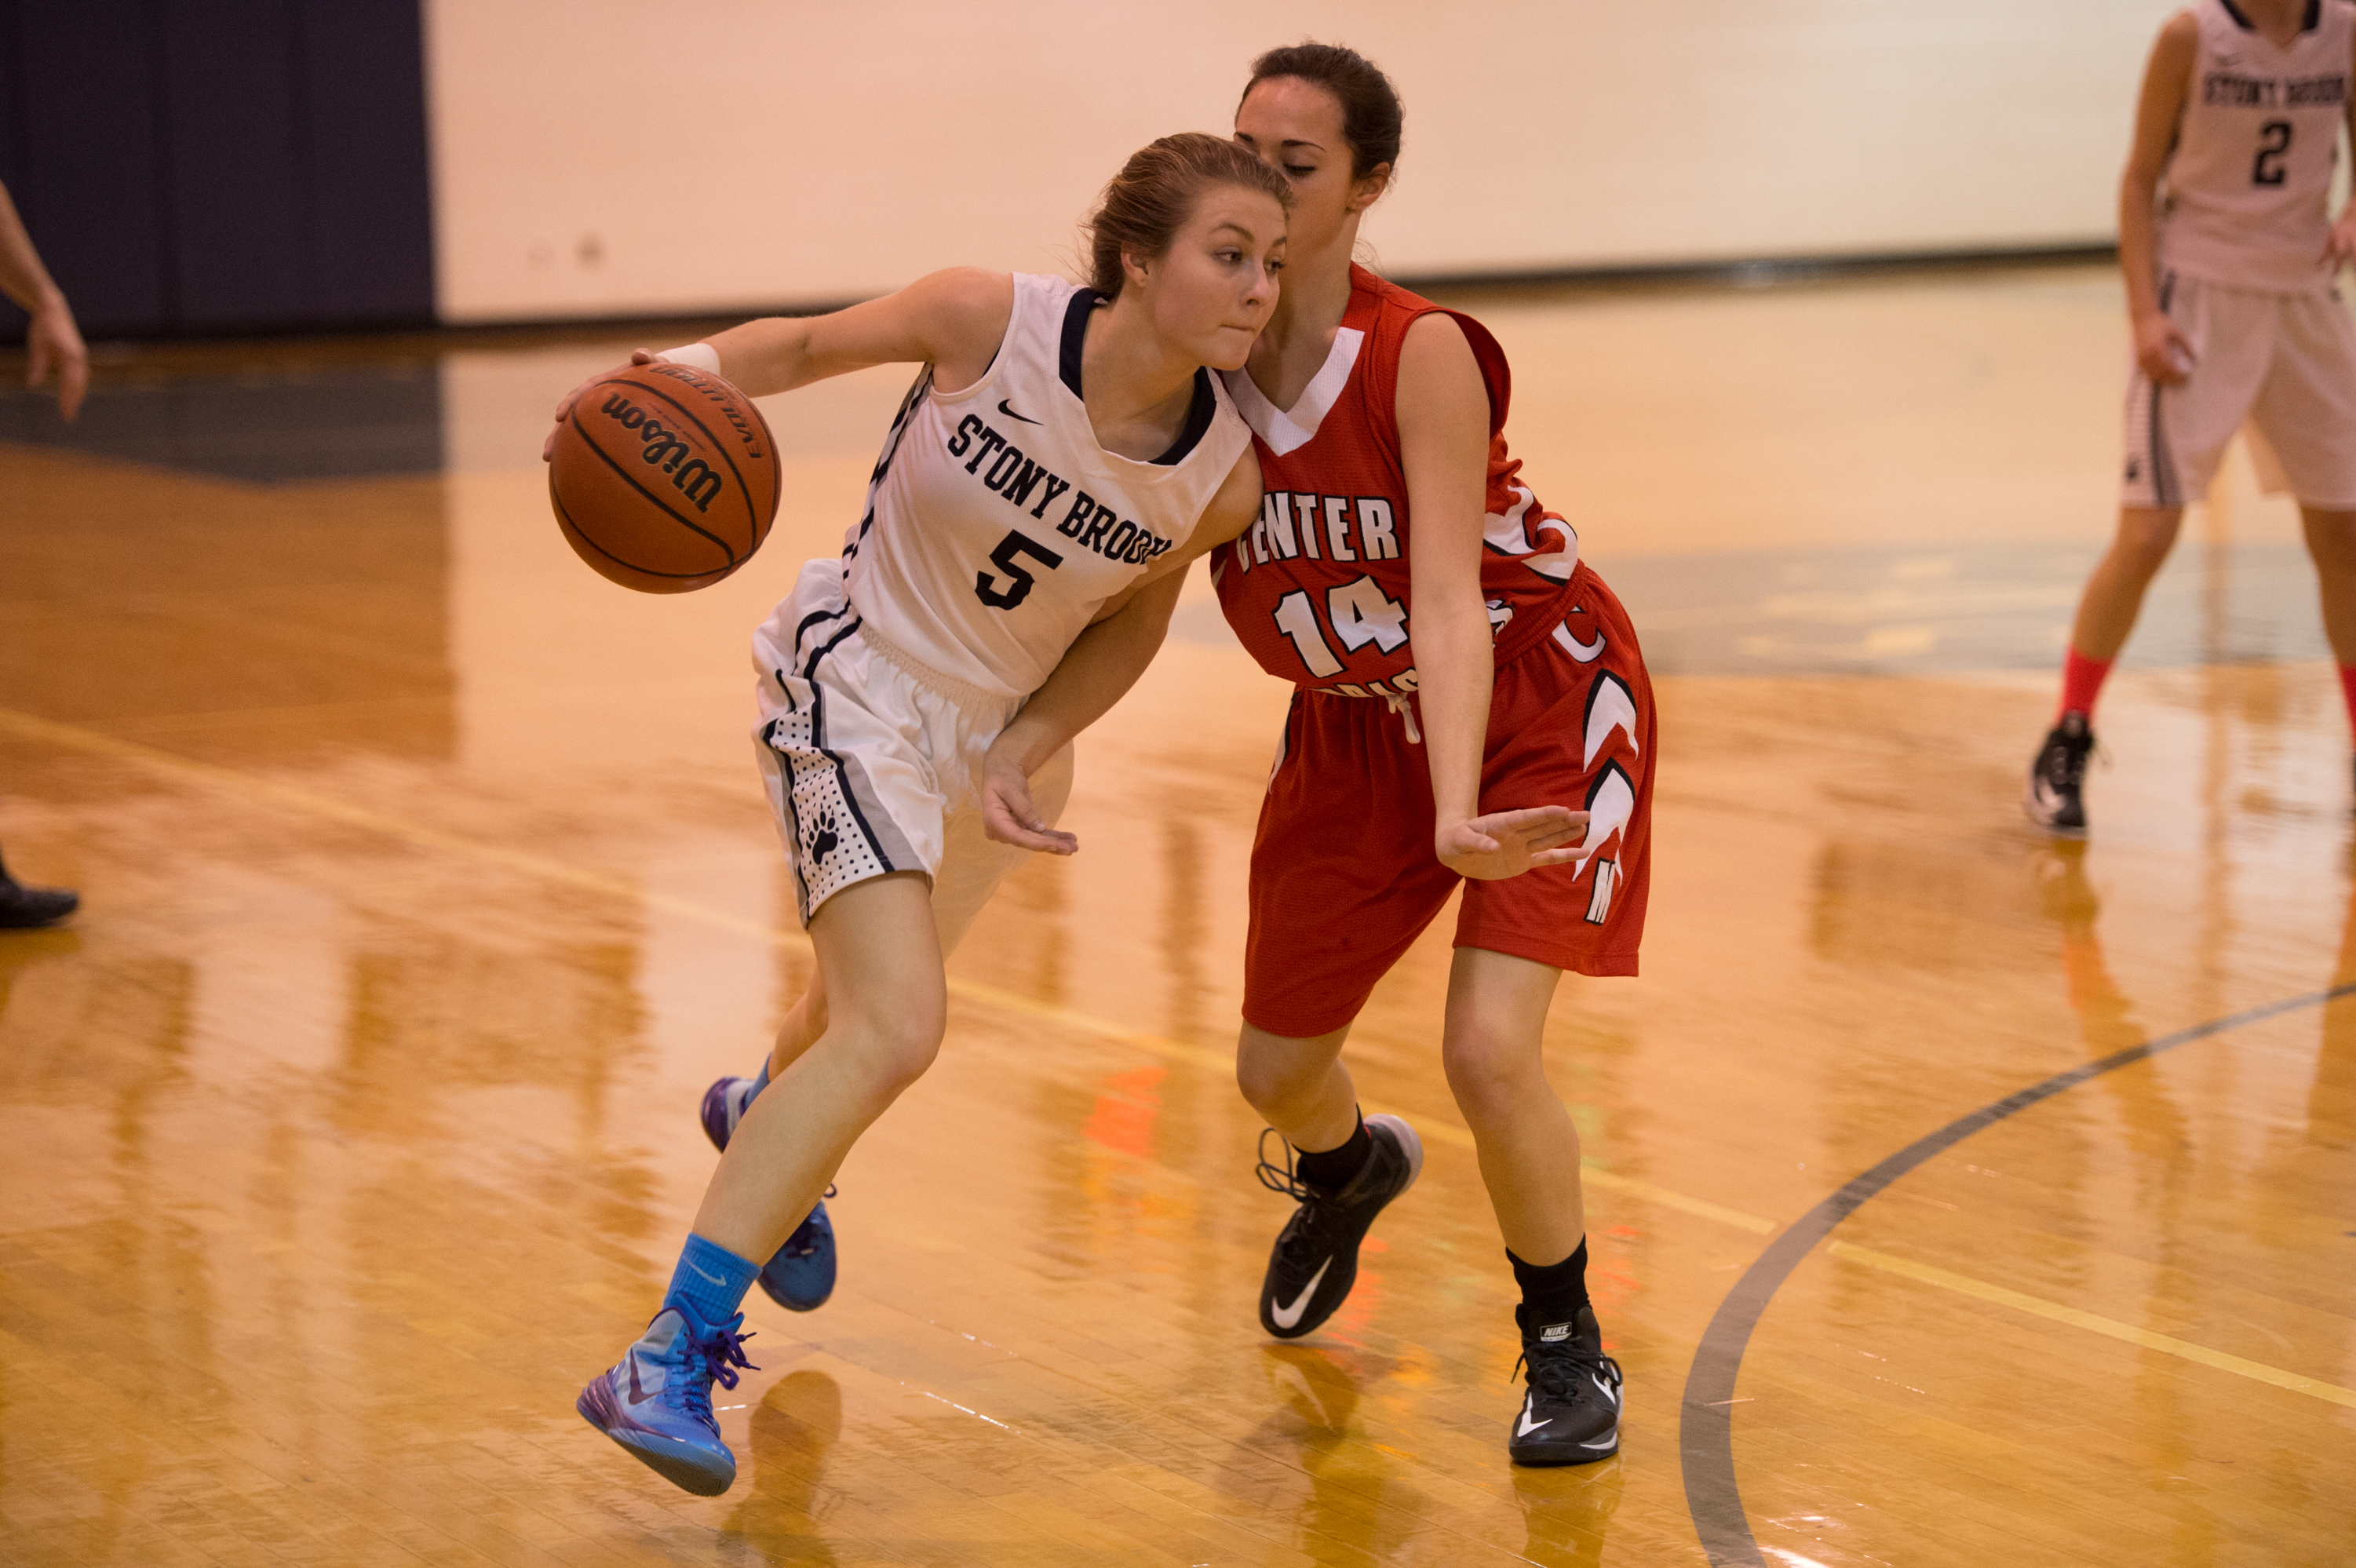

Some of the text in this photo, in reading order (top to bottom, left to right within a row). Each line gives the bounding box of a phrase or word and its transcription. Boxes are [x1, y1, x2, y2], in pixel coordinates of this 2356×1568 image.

[2254, 121, 2292, 184] 2
[601, 392, 723, 513] Wilson
[947, 414, 1070, 520] STONY
[974, 529, 1064, 611] 5
[1272, 574, 1410, 679] 14
[1545, 1325, 1569, 1336] NIKE
